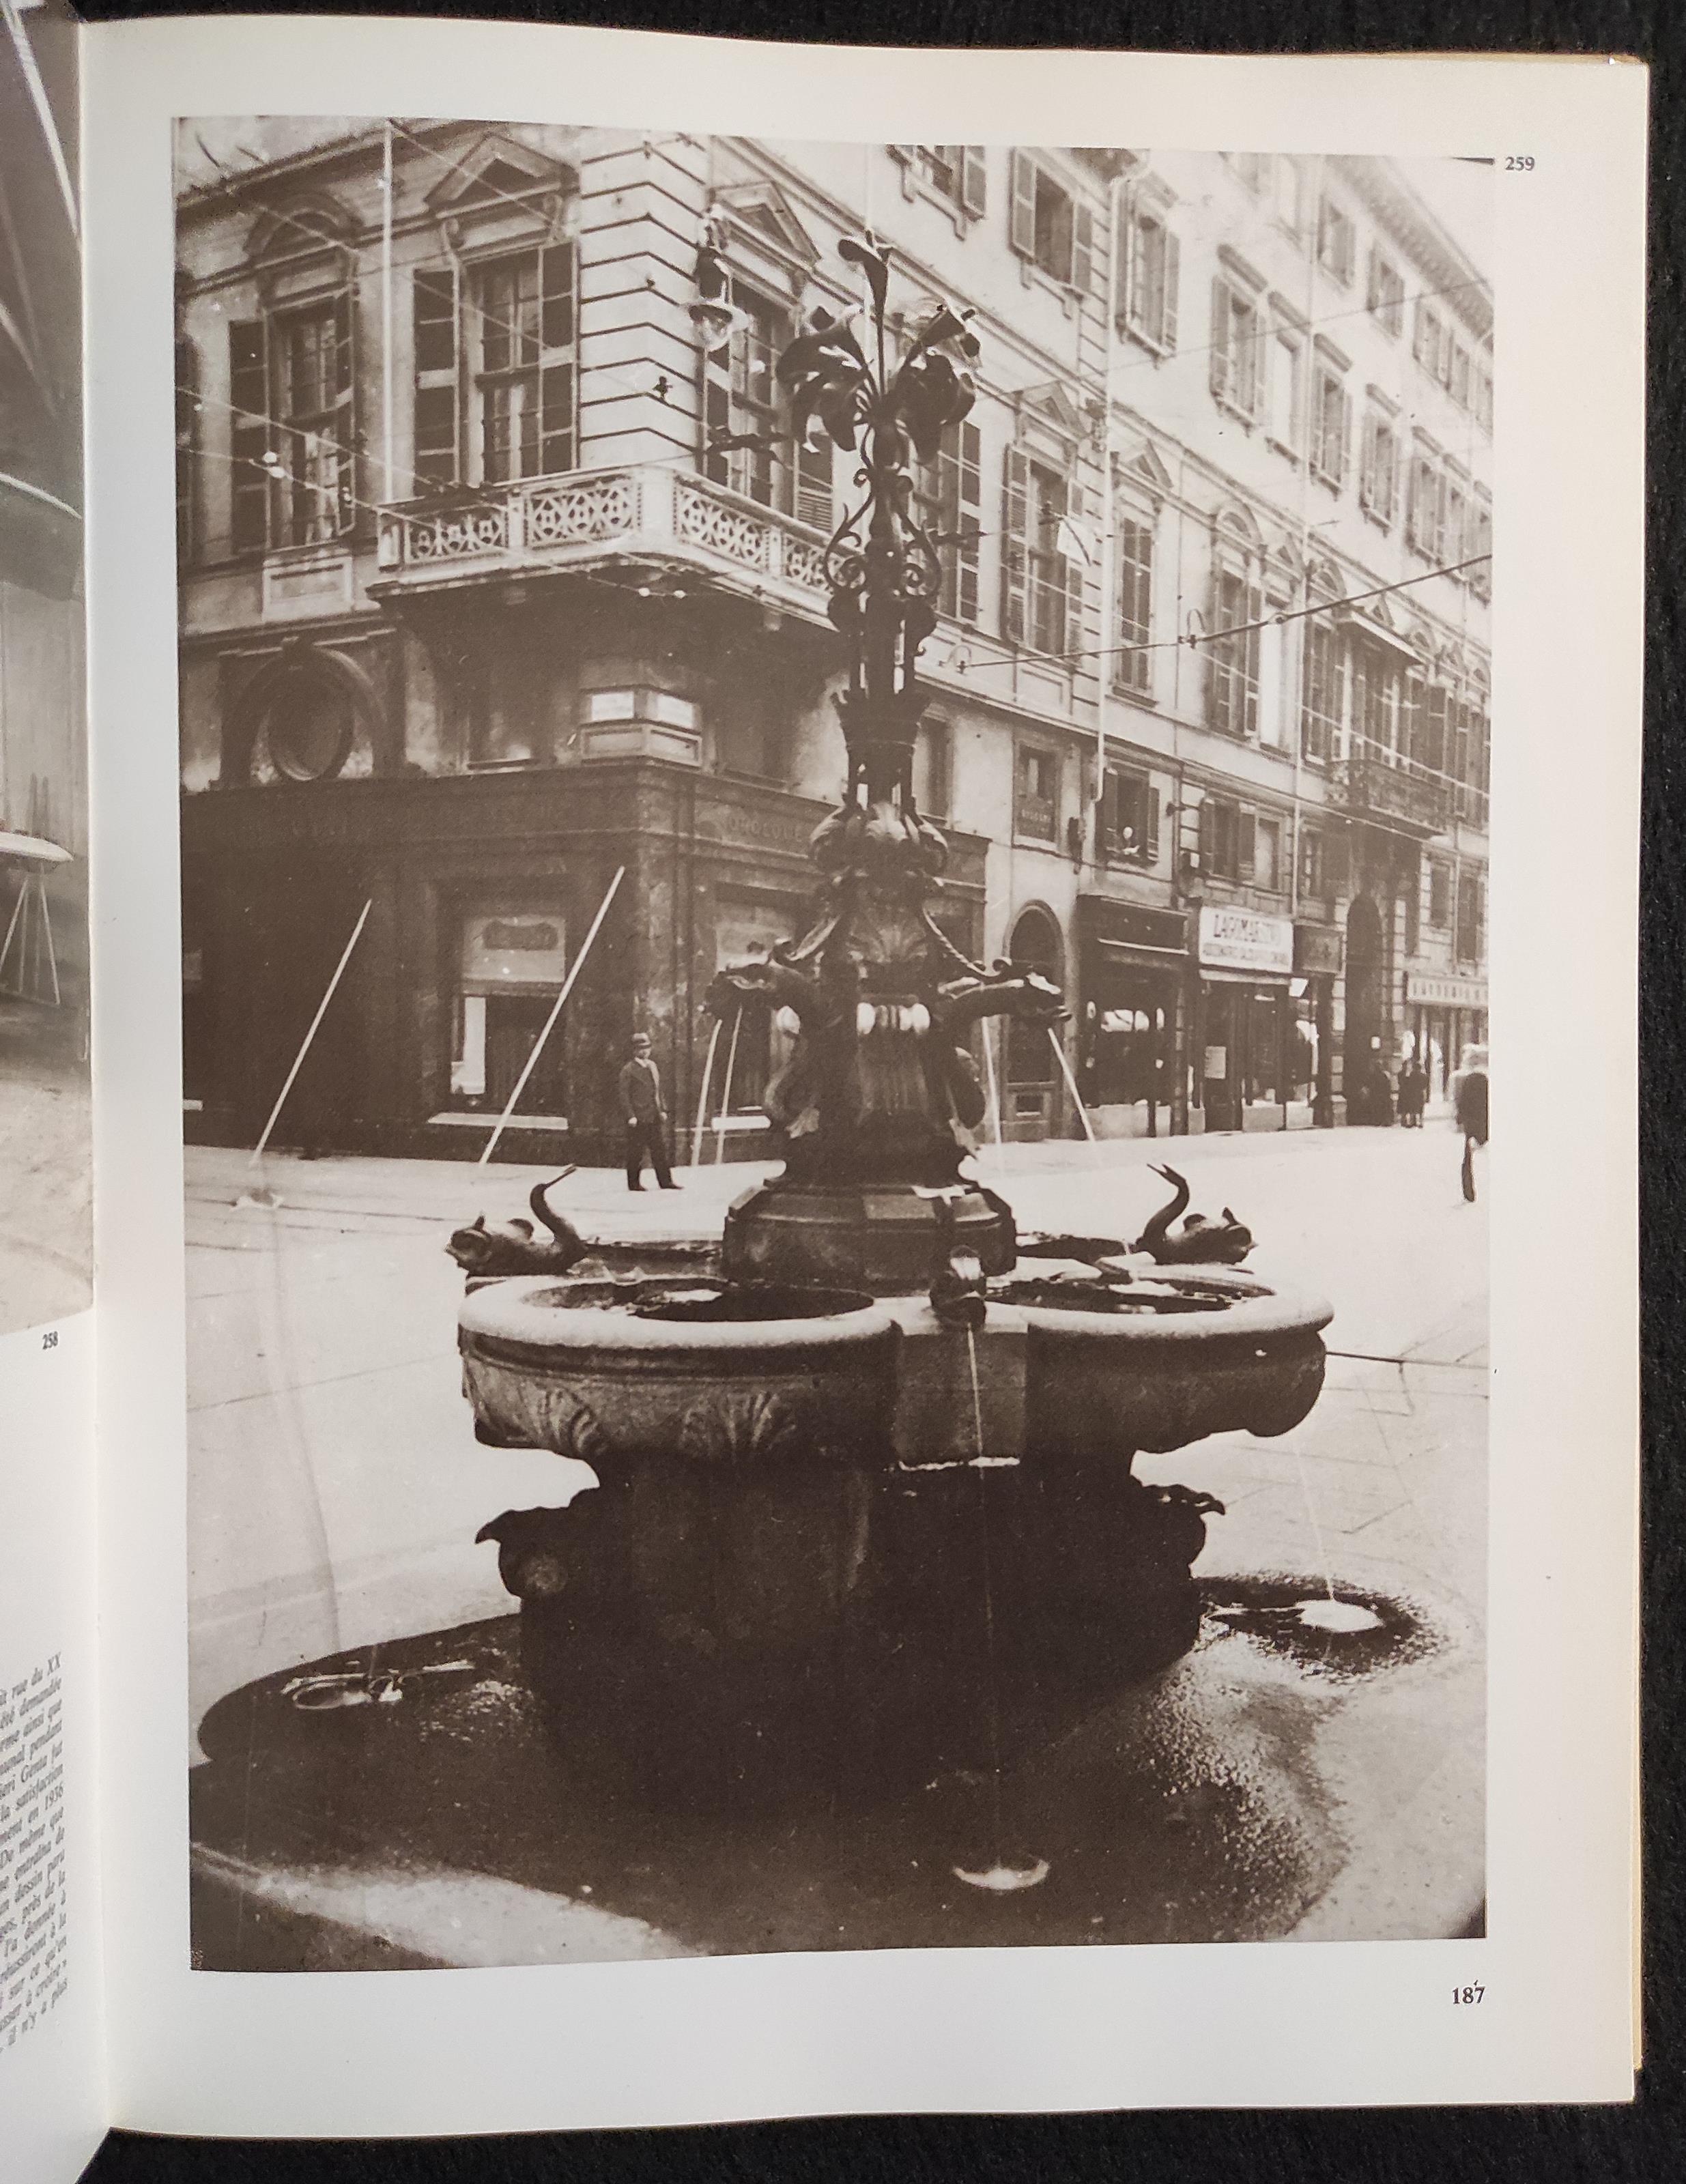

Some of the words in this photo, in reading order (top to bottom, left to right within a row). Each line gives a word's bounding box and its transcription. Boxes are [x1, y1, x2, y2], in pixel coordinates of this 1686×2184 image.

[1505, 156, 1535, 171] 259
[42, 1331, 59, 1350] 258
[31, 1667, 43, 1686] du
[47, 1651, 61, 1676] XX
[48, 1698, 62, 1723] que
[30, 1719, 63, 1761] pendant
[15, 1764, 63, 1811] satisfaction
[1453, 1985, 1485, 2005] 187
